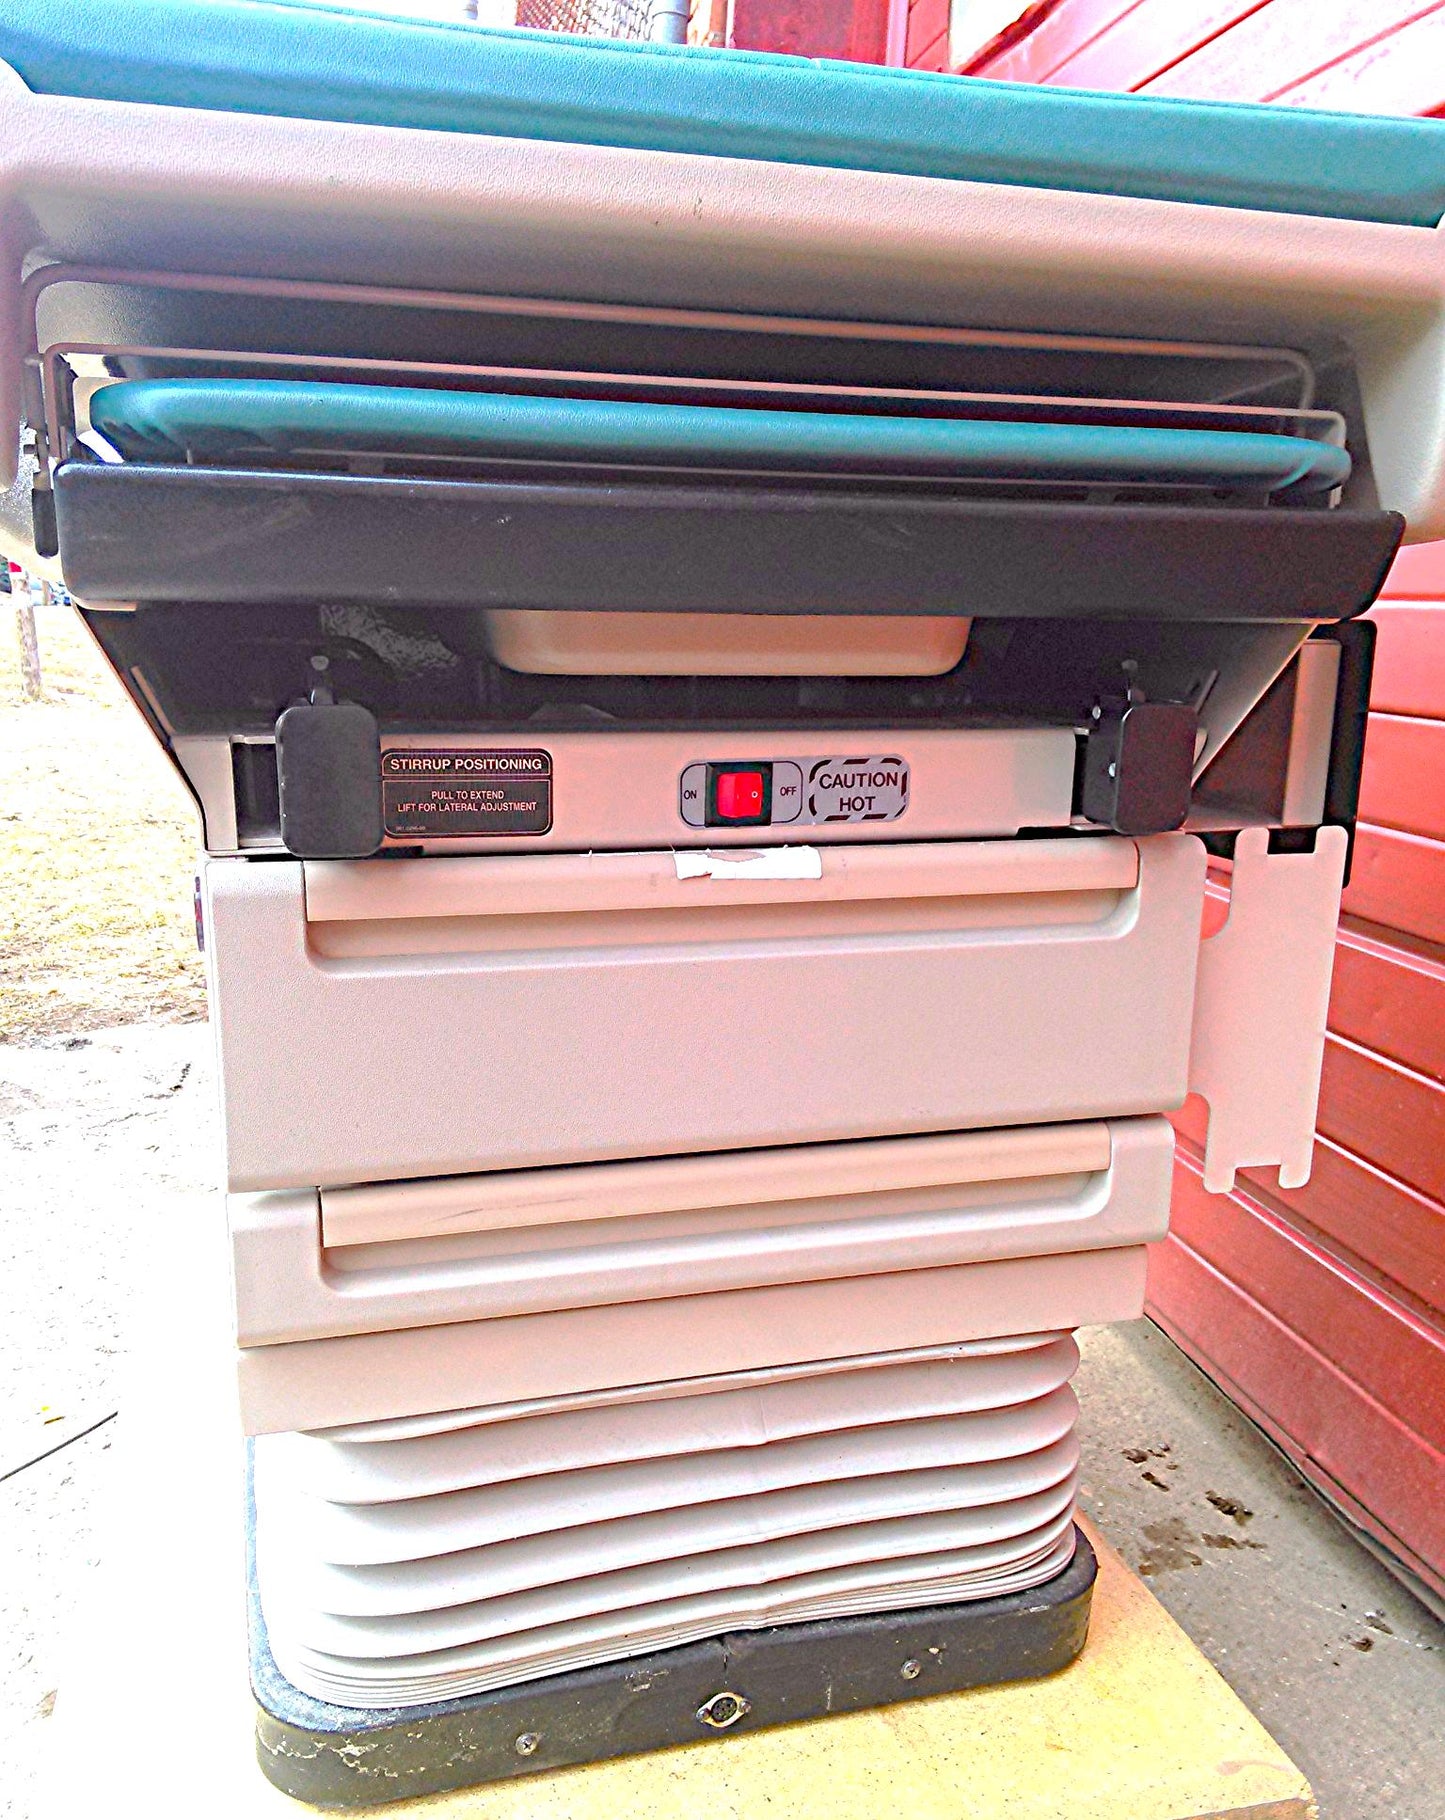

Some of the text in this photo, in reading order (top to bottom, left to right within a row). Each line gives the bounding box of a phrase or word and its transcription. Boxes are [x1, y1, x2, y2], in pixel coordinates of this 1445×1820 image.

[390, 758, 542, 770] STIRRUP POSITIONING
[819, 772, 899, 790] CAUTION
[431, 790, 505, 800] PULL TO EXTEND
[683, 789, 697, 800] ON
[780, 786, 797, 797] OFF
[397, 801, 537, 812] LIFT FOR LATERAL ADJUSTMENT
[839, 796, 876, 812] HOT
